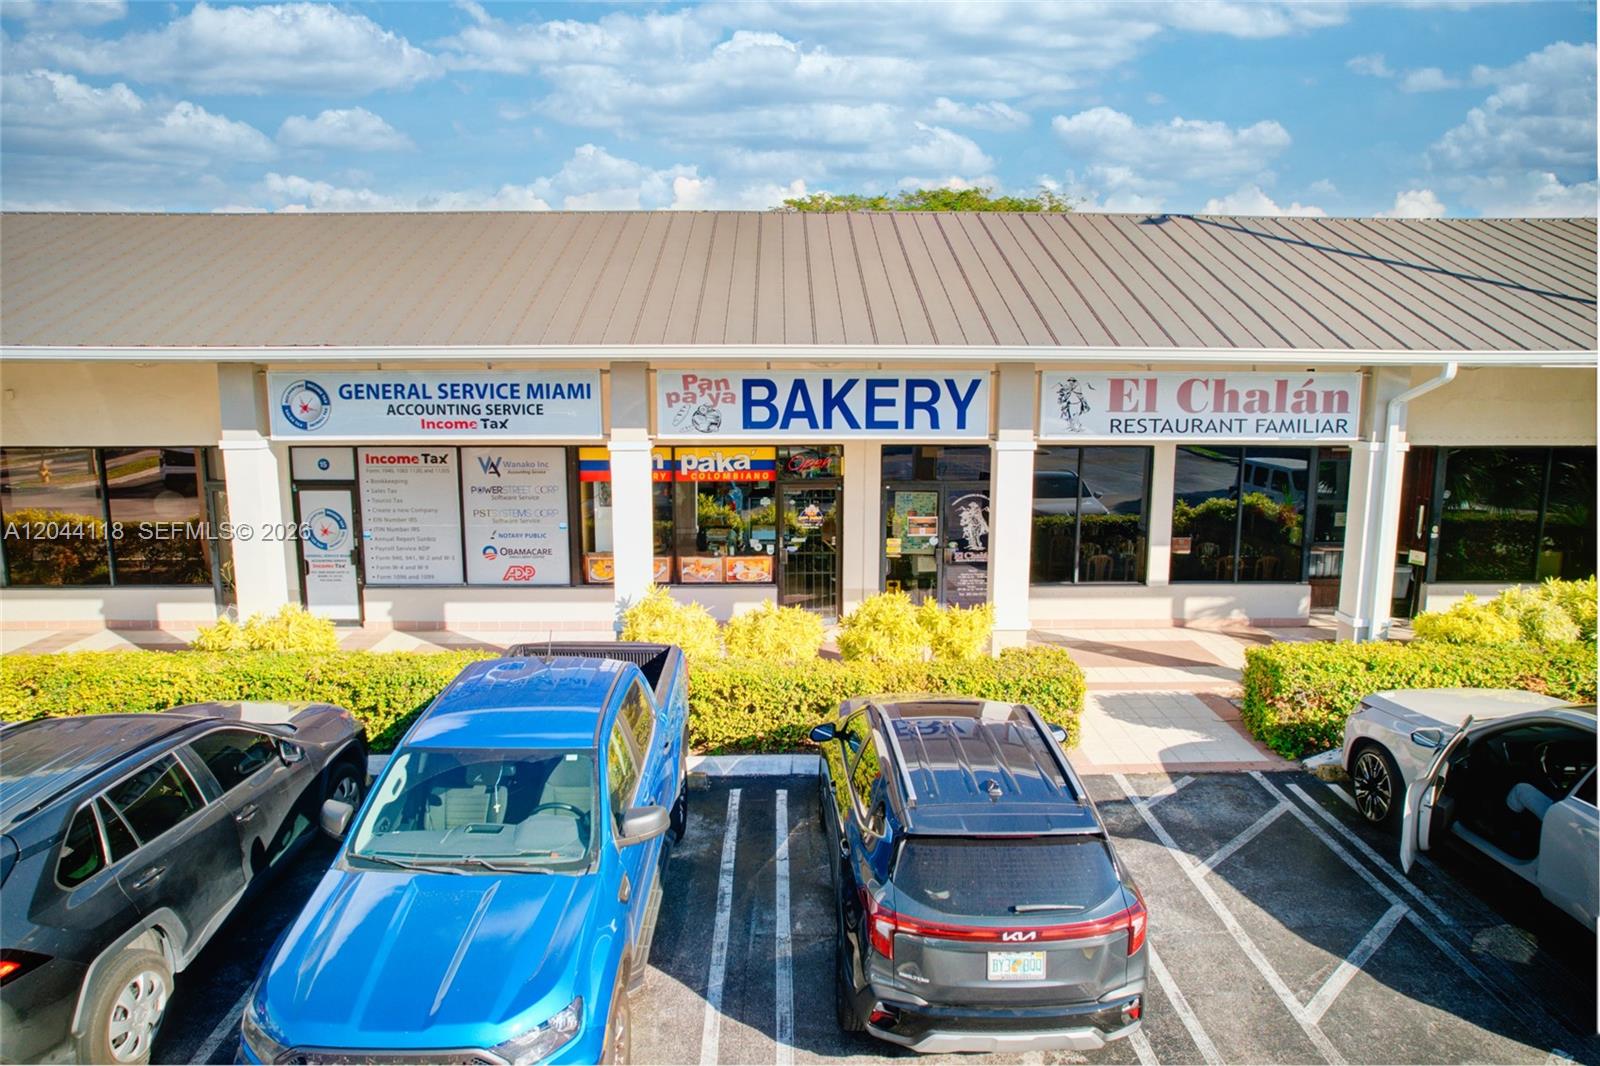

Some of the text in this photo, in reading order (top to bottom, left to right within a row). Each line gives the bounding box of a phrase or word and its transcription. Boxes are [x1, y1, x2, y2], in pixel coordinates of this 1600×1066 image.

[682, 374, 730, 391] Pan
[339, 382, 592, 401] GENERAL SERVICE MIAMI
[1106, 378, 1352, 414] El Chalán
[387, 404, 545, 416] ACCOUNTING SERVICE
[742, 378, 982, 430] BAKERY
[421, 418, 510, 430] Income Tax
[1109, 419, 1348, 433] RESTAURANT FAMILIAR
[365, 453, 449, 465] Income Tax
[503, 460, 550, 468] Wanako Inc
[787, 455, 833, 473] Open
[370, 478, 408, 486] Bookkeeping
[690, 472, 770, 480] COLOMBIANO
[500, 547, 553, 556] OBAMACARE
[503, 565, 536, 581] ADP
